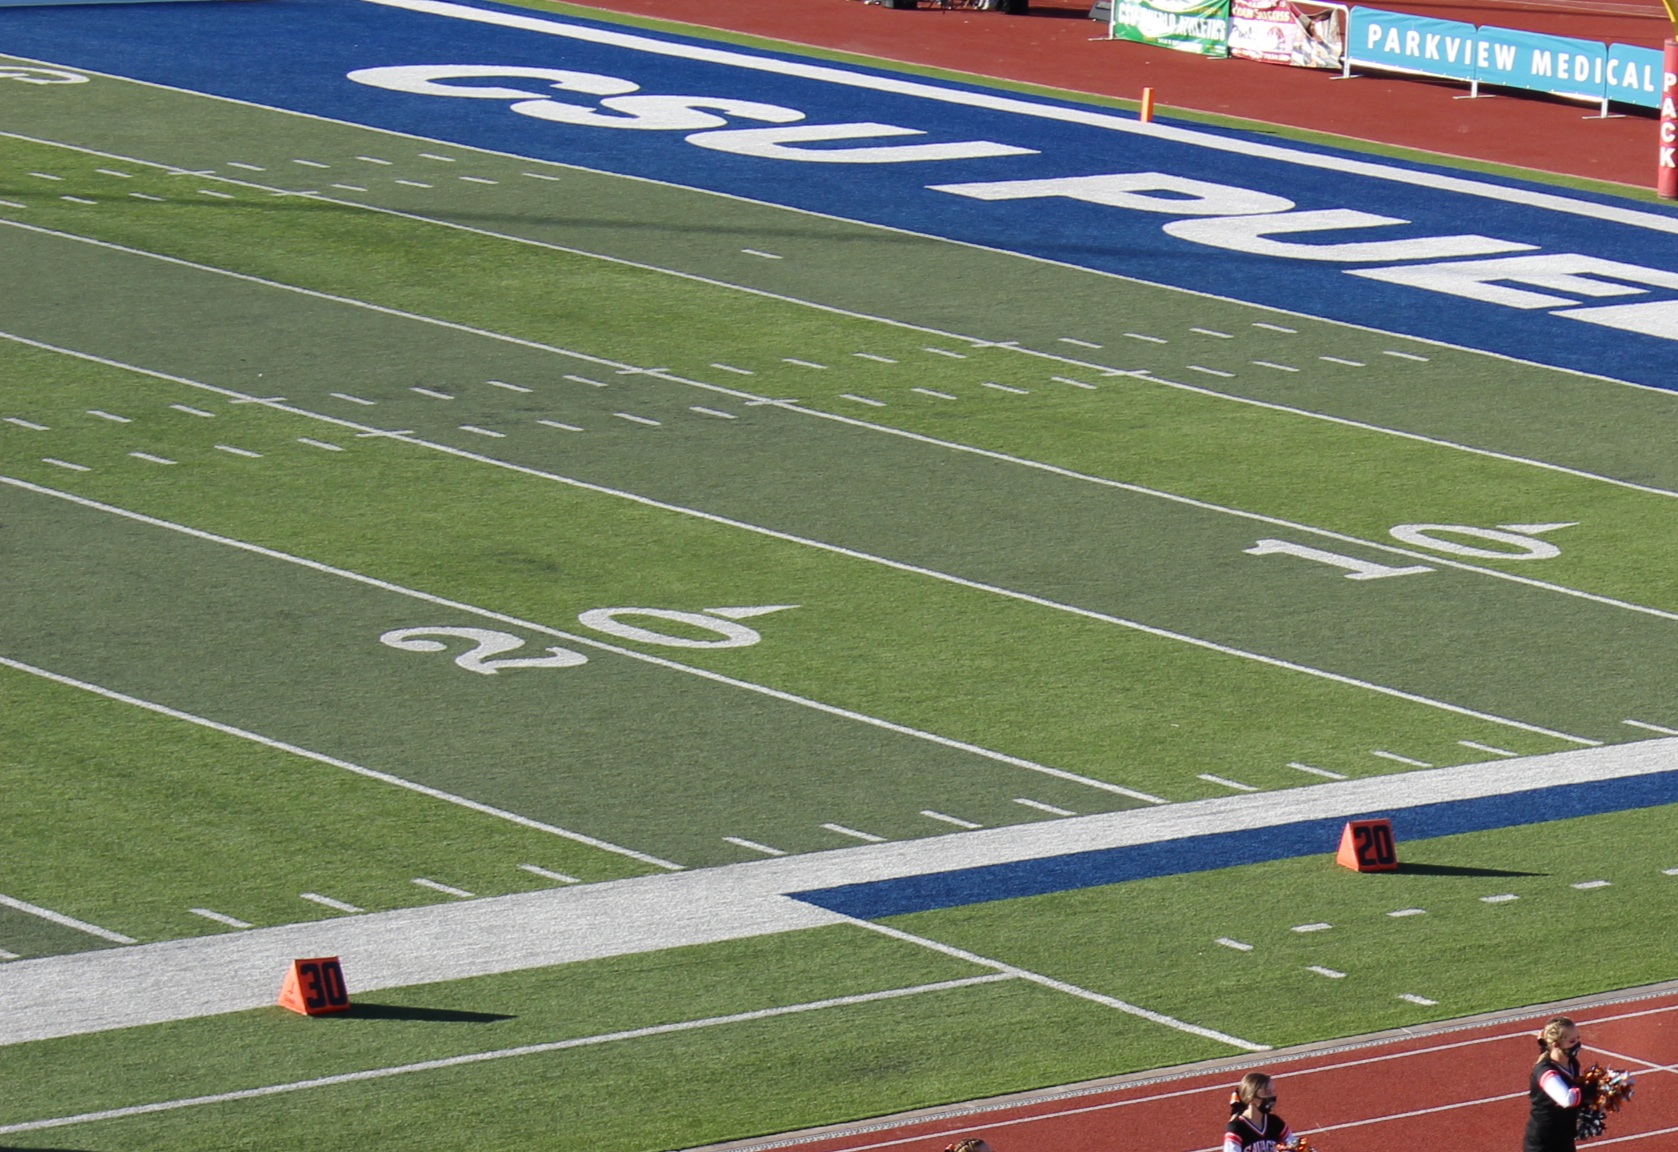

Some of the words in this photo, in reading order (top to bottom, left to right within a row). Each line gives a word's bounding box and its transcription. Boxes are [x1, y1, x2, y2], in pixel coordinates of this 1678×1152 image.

[1367, 24, 1516, 71] PARKVIEW
[1531, 49, 1655, 92] MEDICAL
[346, 65, 1042, 164] CSU
[1658, 72, 1678, 169] PACK
[1243, 523, 1563, 581] 10
[379, 606, 763, 675] 20
[1353, 824, 1396, 867] 20
[300, 961, 348, 1008] 30
